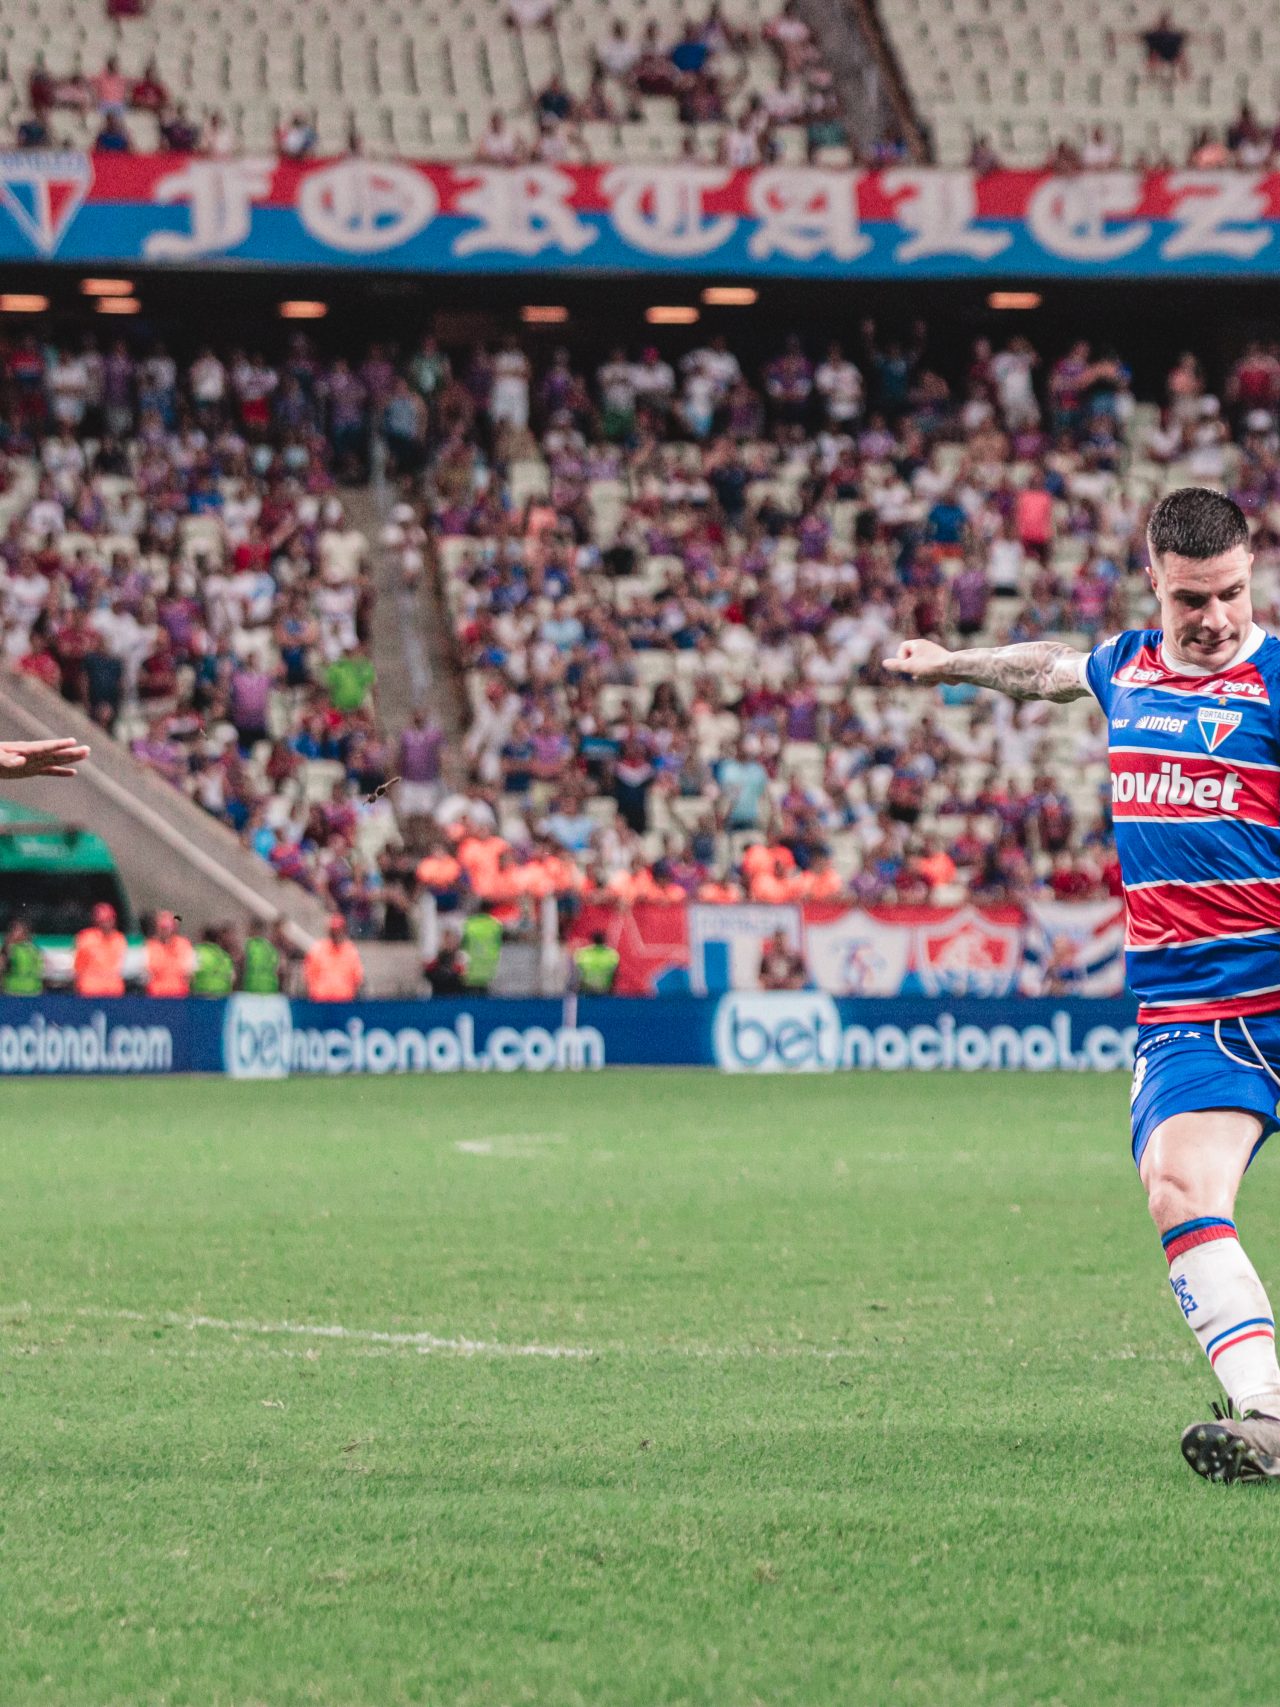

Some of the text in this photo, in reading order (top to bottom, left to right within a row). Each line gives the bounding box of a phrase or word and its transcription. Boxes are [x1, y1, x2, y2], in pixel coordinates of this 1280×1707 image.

[1222, 680, 1265, 696] zenir
[1199, 709, 1241, 721] FORTALEZA
[1147, 716, 1188, 733] inter
